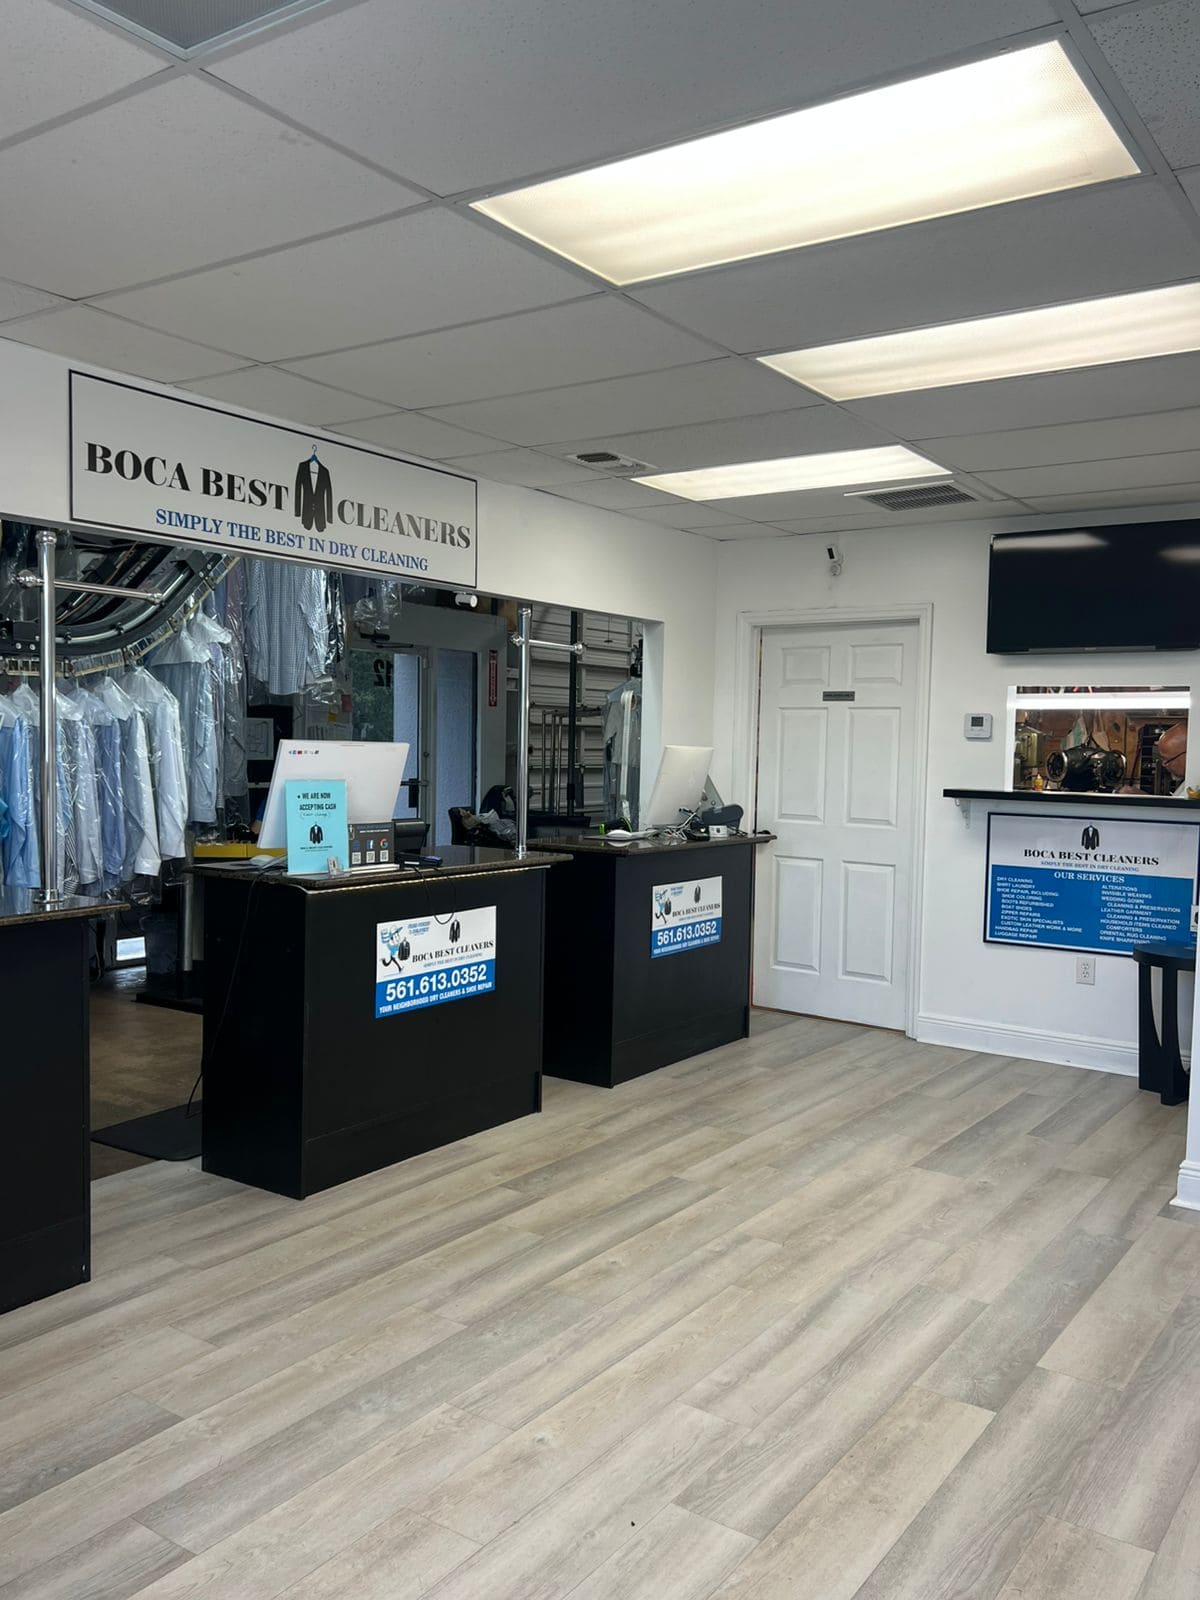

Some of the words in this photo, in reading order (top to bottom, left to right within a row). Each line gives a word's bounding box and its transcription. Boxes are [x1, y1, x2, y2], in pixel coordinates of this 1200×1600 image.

[85, 442, 191, 492] BOCA
[200, 467, 289, 511] BEST
[337, 500, 471, 549] CLEANERS
[156, 509, 222, 534] SIMPLY
[227, 521, 260, 541] THE
[265, 528, 304, 549] BEST
[309, 537, 325, 552] IN
[329, 541, 357, 558] DRY
[361, 547, 428, 571] CLEANING
[299, 803, 324, 811] ACCEPTING
[1023, 849, 1055, 859] BOCA
[1059, 852, 1091, 861] BEST
[1093, 853, 1159, 866] CLEANERS
[1054, 871, 1075, 880] OUR
[1076, 872, 1125, 883] SERVICES
[657, 921, 717, 946] 561.613.0352
[412, 952, 434, 963] BOCA
[434, 948, 455, 959] BEST
[456, 940, 494, 955] CLEANERS
[386, 963, 487, 1002] 561.613.0352
